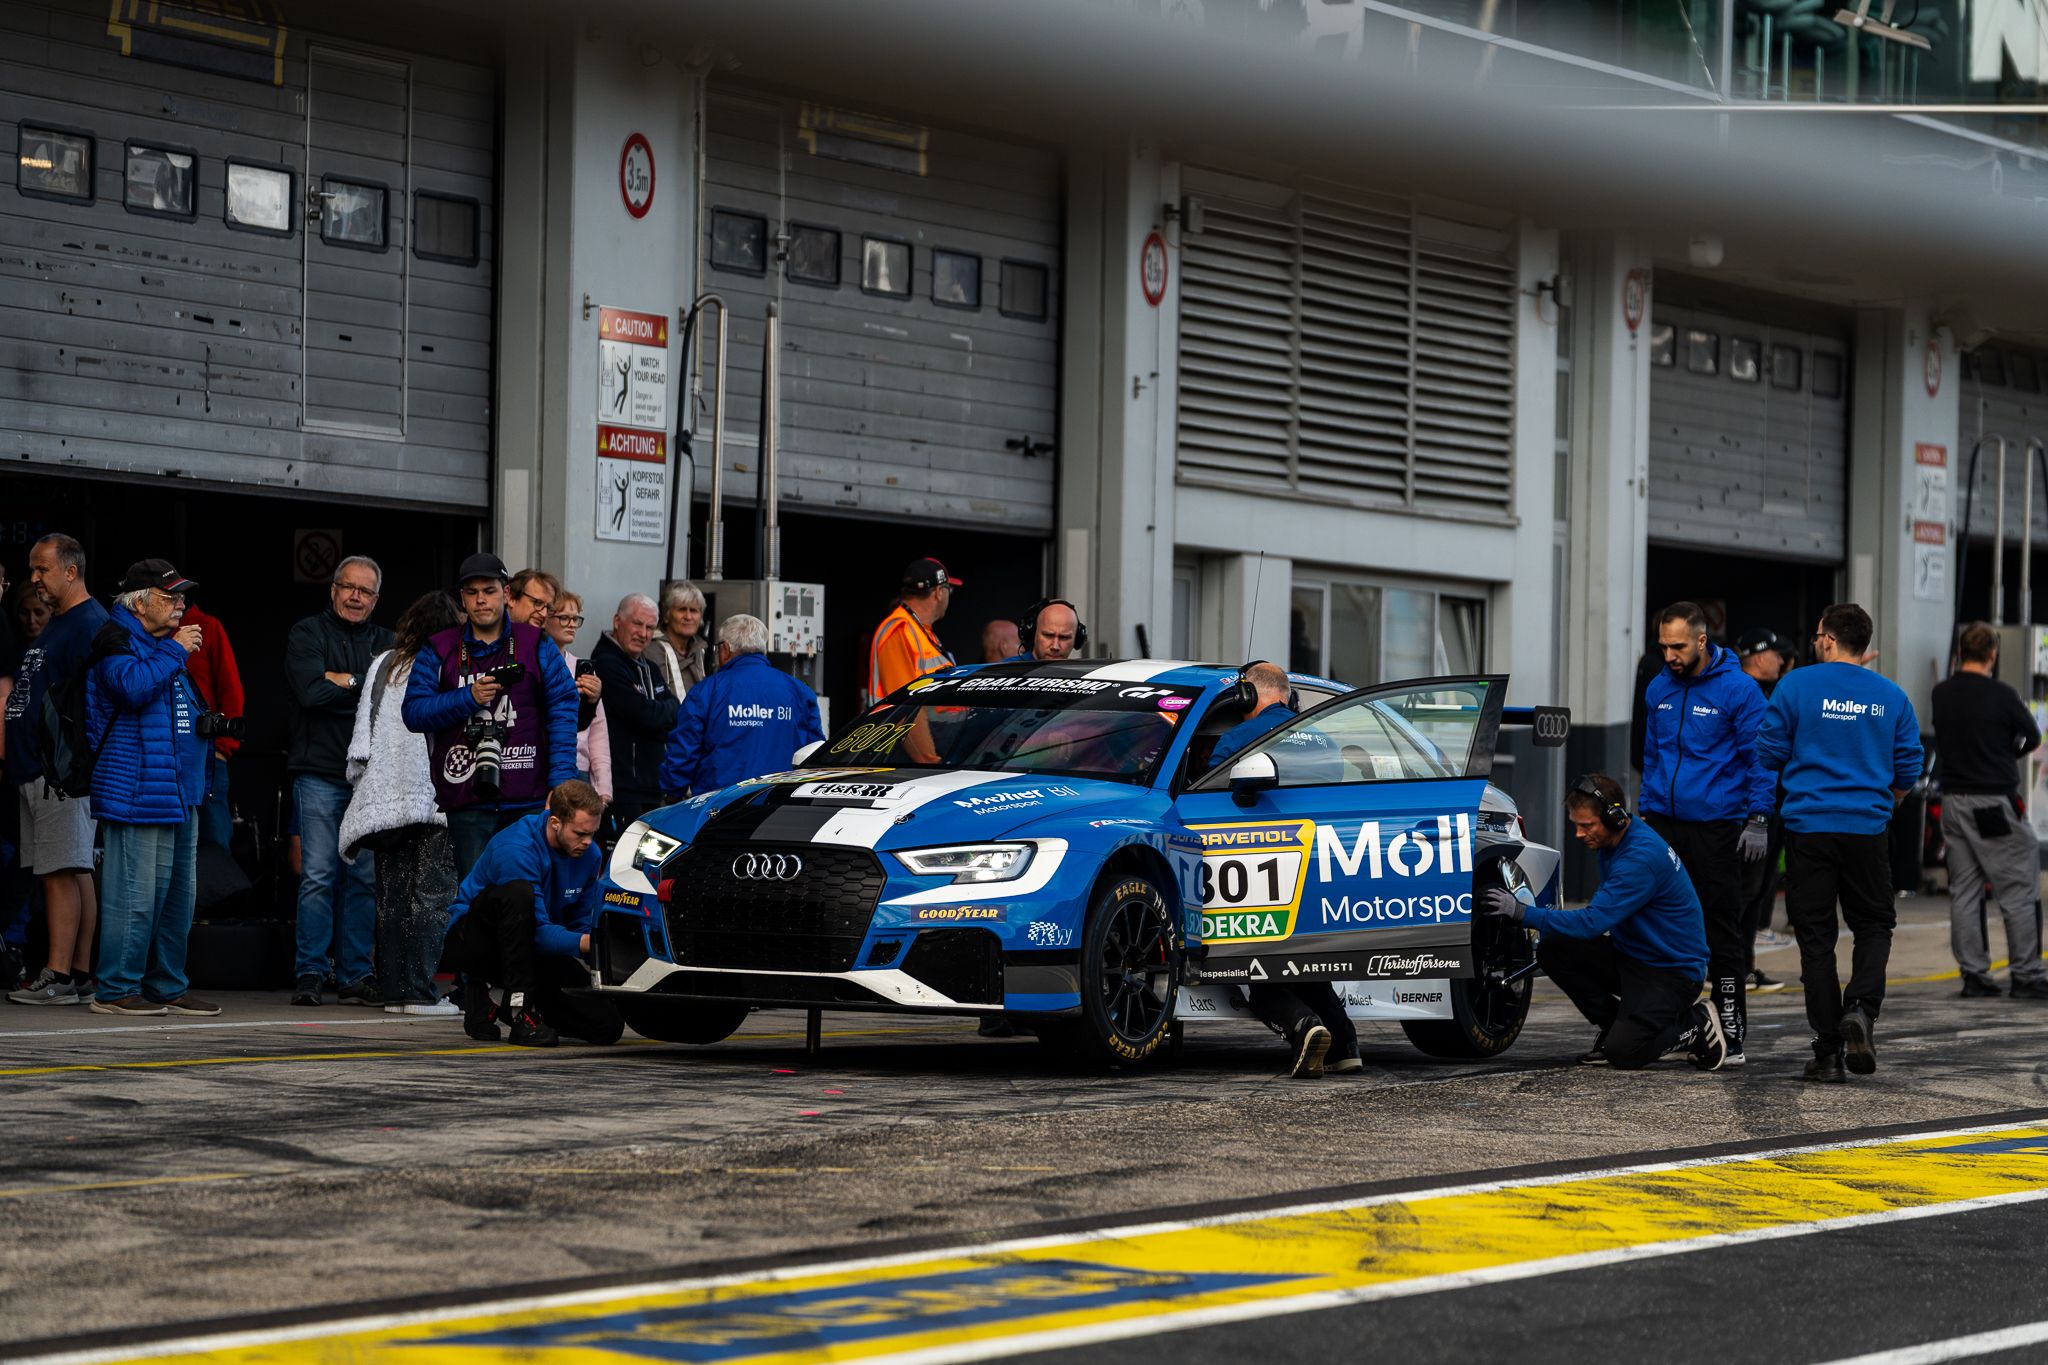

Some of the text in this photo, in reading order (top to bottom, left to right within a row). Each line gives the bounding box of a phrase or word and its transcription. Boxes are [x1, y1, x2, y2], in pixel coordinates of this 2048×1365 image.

[615, 318, 653, 338] CAUTION
[640, 356, 660, 369] WATCH
[634, 370, 666, 385] YOUR HEAD
[609, 433, 656, 456] ACHTUNG
[635, 488, 660, 501] GEFAHR
[961, 677, 1023, 688] GRAN
[1041, 687, 1097, 696] SIMULATOR
[777, 706, 792, 720] Bil
[1822, 712, 1857, 721] Motorsport
[1871, 703, 1884, 717] Bil
[830, 723, 916, 753] 801
[812, 784, 866, 797] H&R
[1047, 785, 1080, 796] Bil
[973, 800, 1043, 815] Motorsport
[604, 892, 640, 906] GOODYEAR
[1115, 882, 1147, 902] EAGLE
[919, 905, 998, 921] GOODYEAR
[1202, 913, 1280, 938] DEKRA
[1303, 962, 1353, 973] ARTISTI
[1367, 954, 1452, 976] Christoffersen
[1189, 995, 1217, 1011] Aars
[1401, 992, 1443, 1004] BERNER
